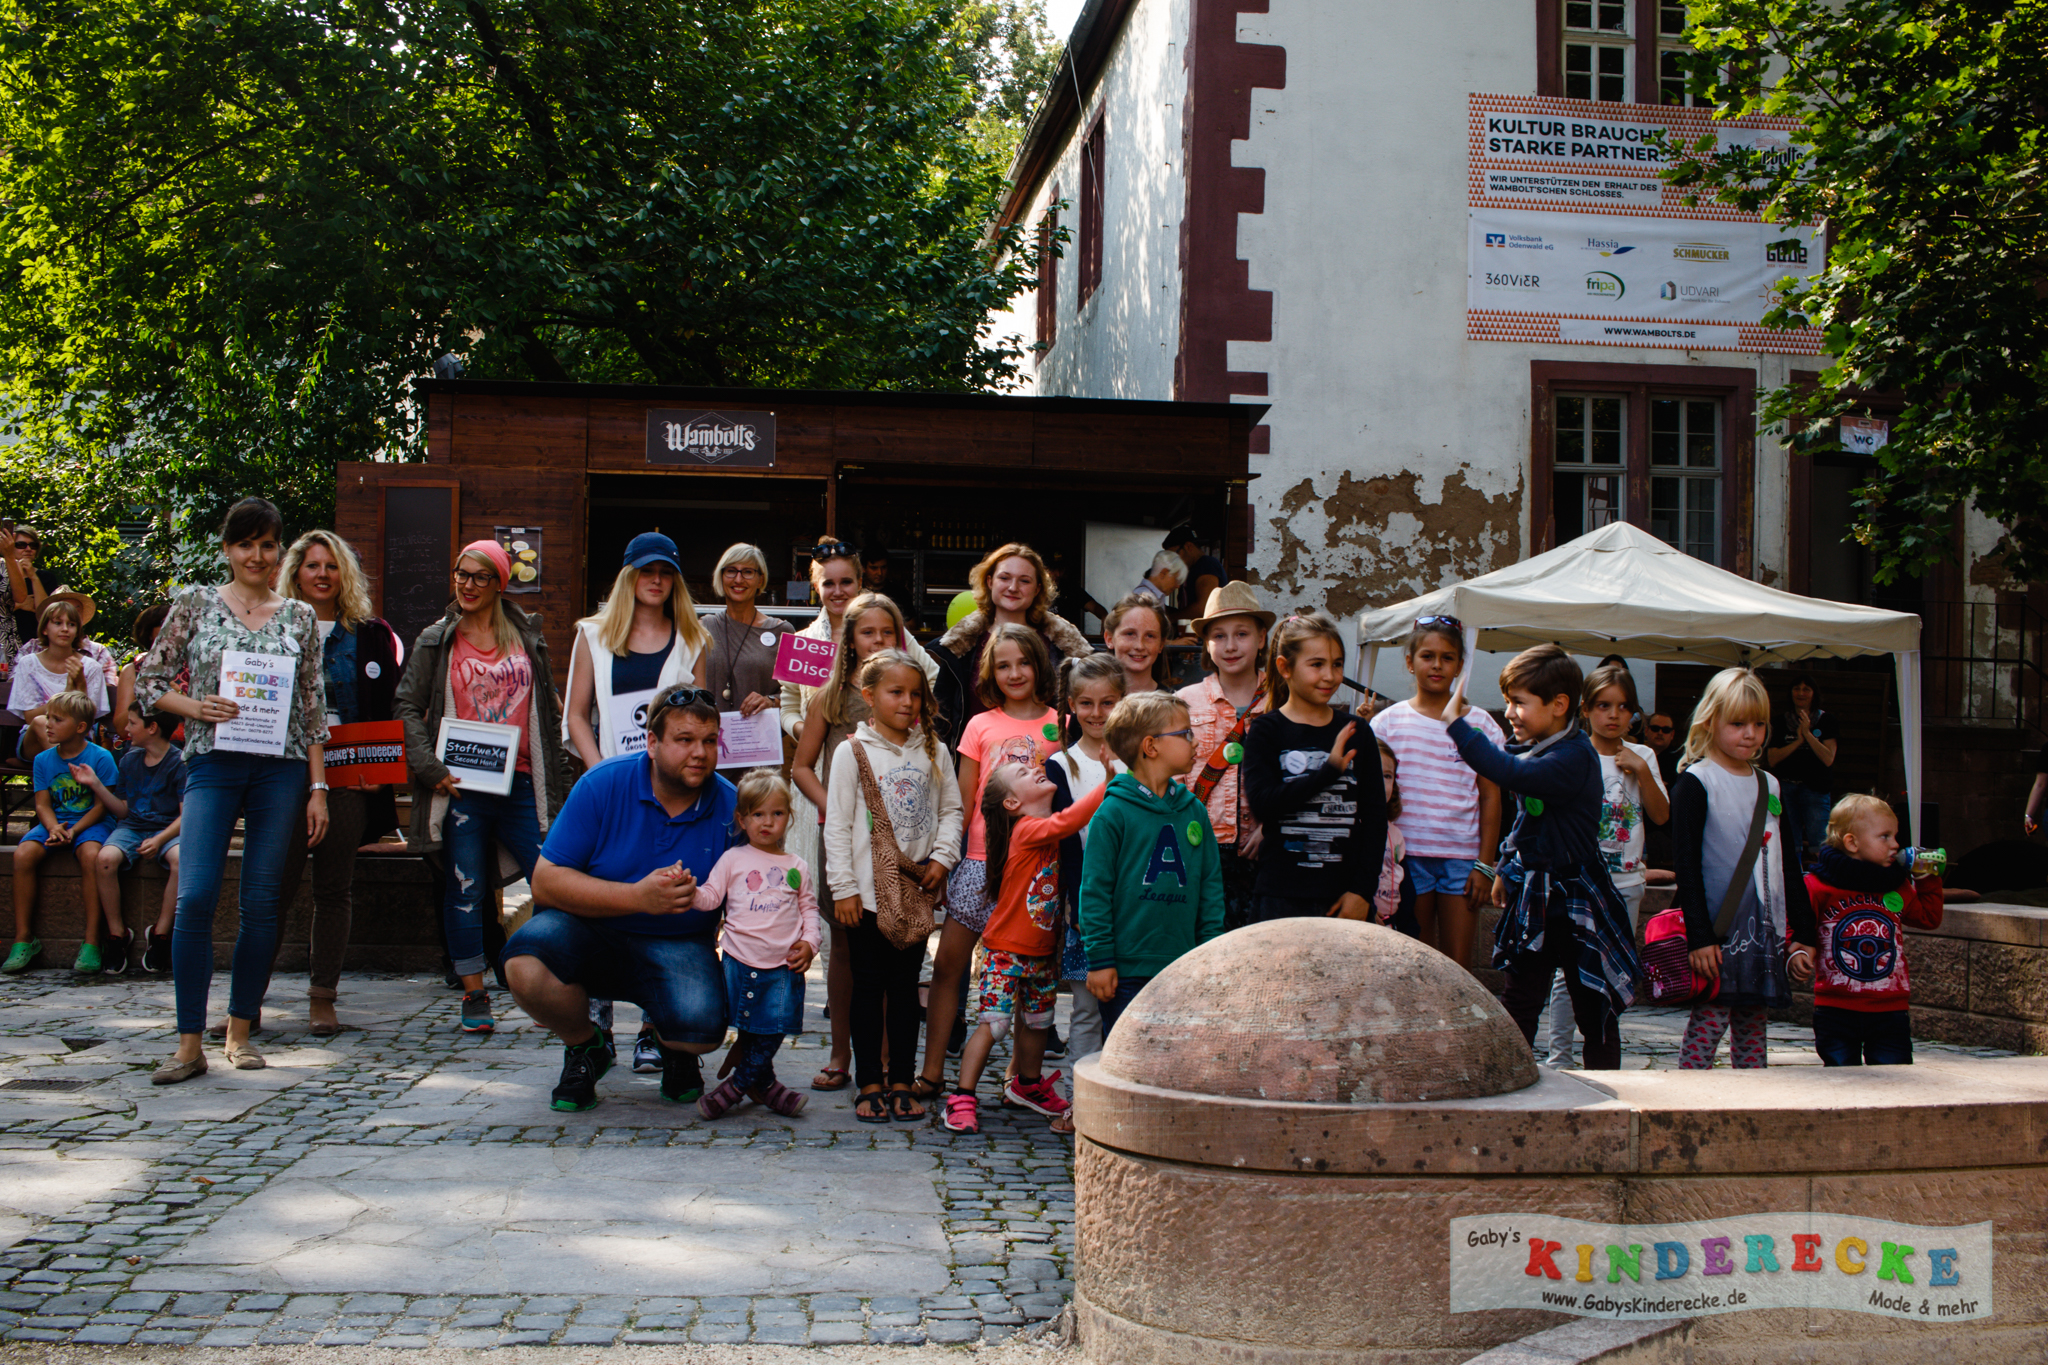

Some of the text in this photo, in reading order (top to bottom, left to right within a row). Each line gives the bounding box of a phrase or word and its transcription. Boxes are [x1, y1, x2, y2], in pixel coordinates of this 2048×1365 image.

[1489, 118, 1566, 137] KULTUR
[1489, 138, 1665, 162] STARKE PARTNER.
[1489, 175, 1657, 192] WIR UNTERSTÜTZEN DEN ERHALT DES
[1569, 188, 1625, 199] SCHLOSSES.
[1509, 235, 1543, 243] Volksbank
[1509, 242, 1543, 250] Odenwald
[1587, 238, 1619, 249] Hassia
[1673, 248, 1730, 261] SCHMUCKER
[1586, 277, 1616, 292] fripa
[1680, 285, 1720, 297] UDVARI
[1604, 327, 1697, 339] WWW.WAMBOLTS.DE
[661, 421, 757, 451] Wambolts
[1854, 434, 1874, 446] WC
[793, 637, 836, 657] Desi
[225, 671, 289, 688] KINDER
[235, 686, 278, 701] ECKE
[252, 705, 258, 713] &
[259, 707, 280, 715] mehr
[453, 755, 498, 768] Second Hand
[1142, 823, 1188, 887] A
[1139, 887, 1188, 906] League
